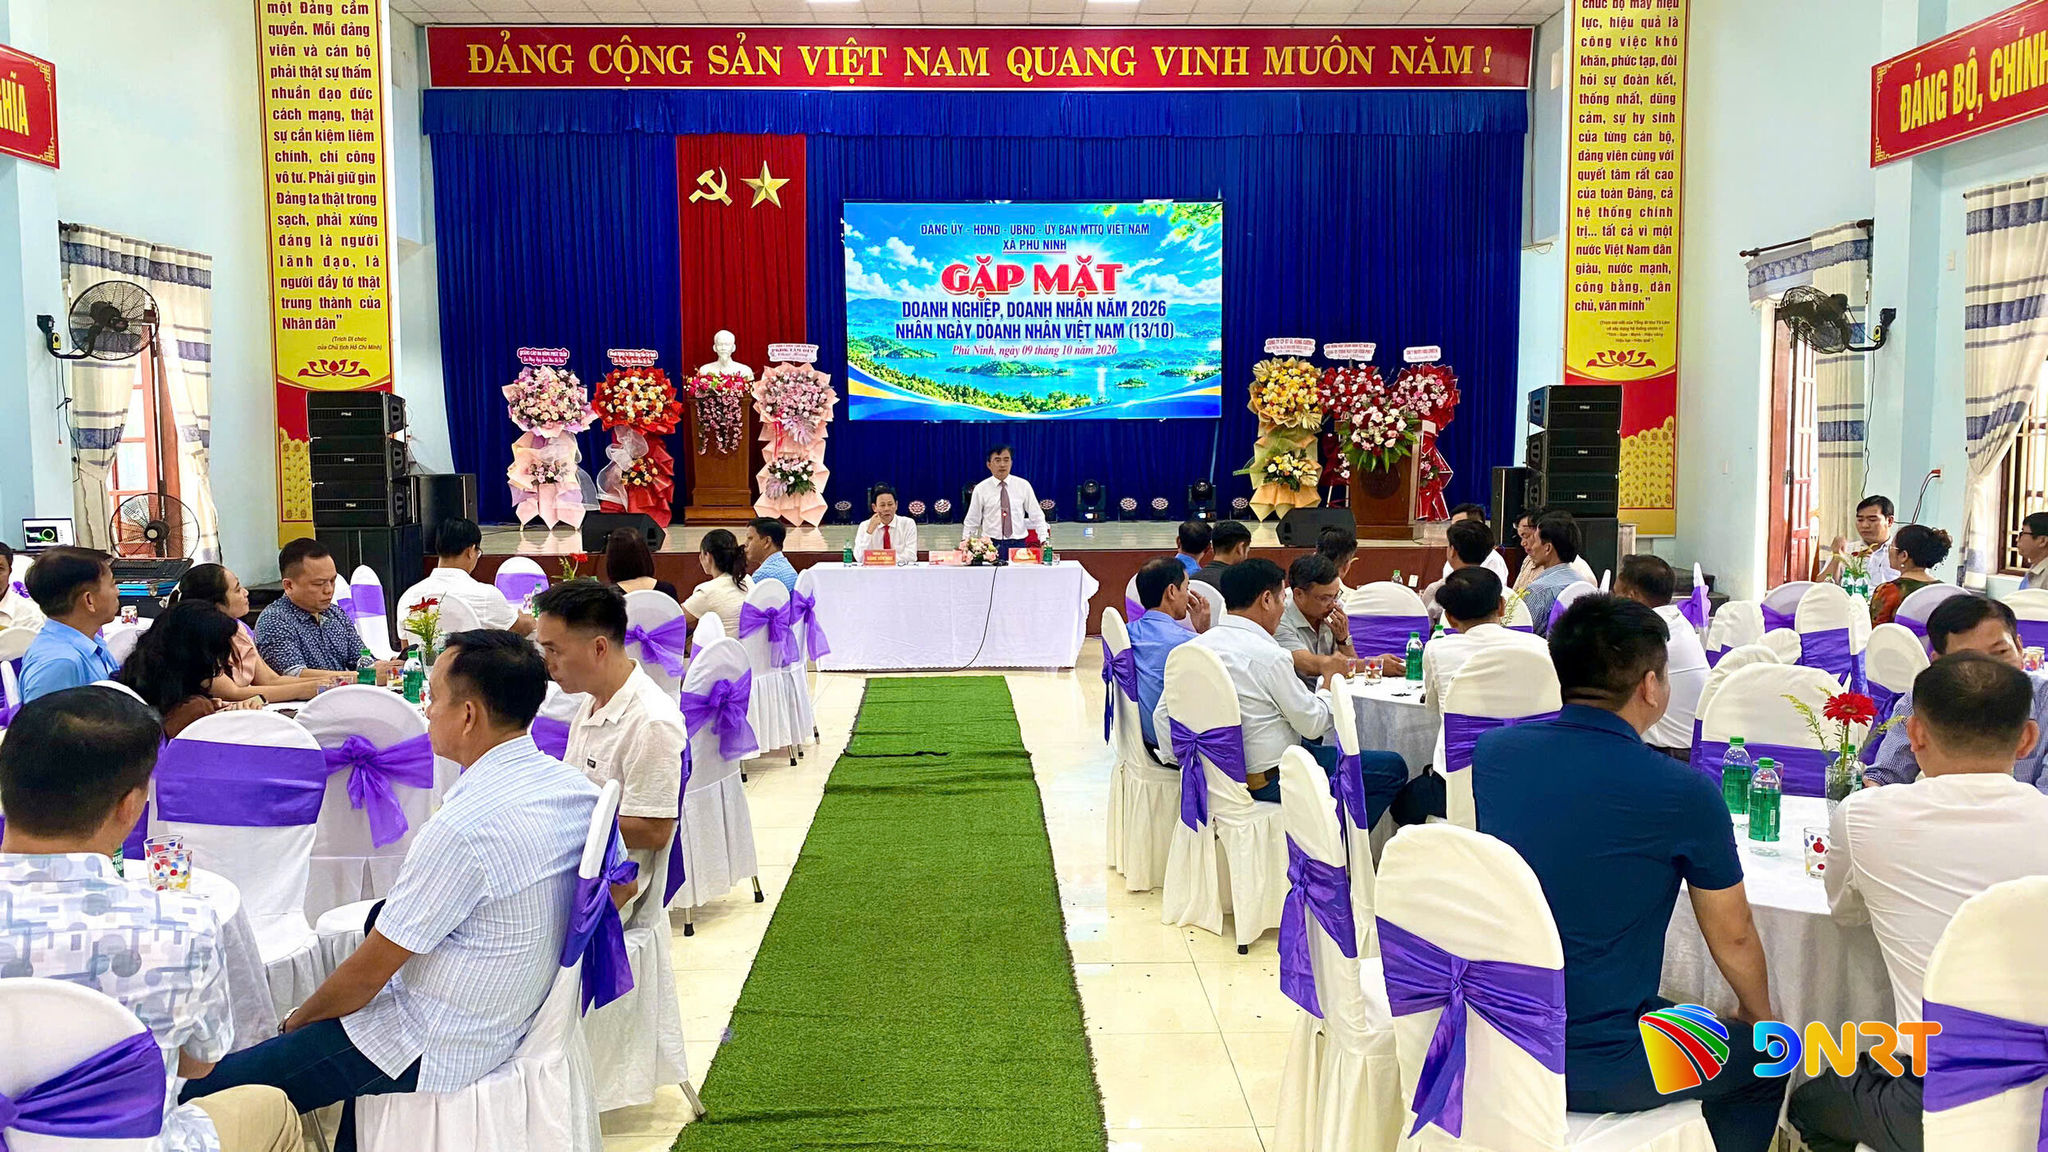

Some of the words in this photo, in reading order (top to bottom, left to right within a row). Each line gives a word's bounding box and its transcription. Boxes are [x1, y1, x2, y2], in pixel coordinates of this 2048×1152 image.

[268, 1, 291, 16] một
[300, 0, 332, 15] Đảng
[342, 0, 368, 14] cầm
[269, 21, 307, 36] quyền.
[313, 21, 335, 35] Mỗi
[341, 22, 369, 37] đảng
[1582, 17, 1602, 30] lực,
[1610, 17, 1633, 30] hiệu
[1641, 15, 1660, 29] quả
[1669, 16, 1678, 27] là
[1582, 36, 1611, 48] công
[1620, 36, 1646, 49] việc
[1656, 36, 1677, 46] khó
[269, 44, 295, 56] viên
[304, 44, 317, 56] và
[326, 45, 347, 57] cán
[356, 45, 370, 59] bộ
[467, 31, 574, 74] ĐẢNG
[588, 35, 693, 83] CỘNG
[708, 32, 783, 76] SẢN
[798, 37, 888, 85] VIỆT
[903, 46, 990, 77] NAM
[1006, 45, 1137, 83] QUANG
[1152, 45, 1249, 76] VINH
[1262, 35, 1375, 76] MUÔN
[1390, 37, 1474, 75] NĂM
[1581, 55, 1608, 67] khăn,
[1612, 55, 1636, 67] phức
[1640, 56, 1658, 68] tạp,
[1661, 55, 1677, 65] đòi
[271, 64, 296, 79] phải
[300, 66, 322, 80] thật
[326, 67, 339, 80] sự
[342, 64, 371, 78] thấm
[272, 85, 310, 99] nhuần
[319, 87, 341, 102] đạo
[350, 87, 372, 99] đức
[1900, 62, 1948, 133] ĐẢNG
[1953, 46, 1983, 122] BỘ,
[1580, 92, 1609, 105] thống
[1617, 91, 1642, 105] nhất,
[1650, 93, 1675, 105] dũng
[273, 108, 301, 120] cách
[308, 111, 344, 123] mạng,
[351, 108, 373, 123] thật
[1579, 111, 1605, 124] cảm,
[1613, 114, 1626, 125] sự
[1633, 112, 1645, 124] hy
[1653, 112, 1675, 123] sinh
[1579, 130, 1597, 142] của
[1604, 131, 1626, 143] từng
[1634, 131, 1652, 142] cán
[1659, 131, 1674, 144] bộ,
[275, 150, 311, 163] chính,
[320, 151, 338, 162] chí
[347, 151, 375, 164] công
[1579, 149, 1603, 162] đảng
[1607, 150, 1627, 161] viên
[1631, 150, 1656, 162] cùng
[1659, 150, 1673, 160] với
[1578, 167, 1605, 181] quyết
[1611, 169, 1630, 179] tâm
[1636, 167, 1649, 179] rất
[1655, 171, 1673, 179] cao
[1578, 187, 1596, 198] của
[1601, 188, 1622, 198] toàn
[1627, 187, 1656, 200] Đảng,
[1661, 187, 1673, 198] cả
[1577, 207, 1590, 220] hệ
[1599, 205, 1631, 218] thống
[1640, 206, 1672, 217] chính
[278, 214, 309, 228] sạch,
[317, 212, 341, 226] phải
[350, 214, 377, 227] xứng
[974, 224, 1000, 235] HĐND
[1010, 224, 1036, 235] UBND
[1058, 224, 1078, 235] BAN
[1081, 224, 1104, 236] MTTQ
[1106, 221, 1125, 235] VIỆT
[1128, 224, 1150, 235] NAM
[279, 234, 311, 247] đáng
[321, 234, 333, 246] là
[342, 235, 378, 247] người
[1043, 240, 1067, 250] NINH
[1576, 244, 1601, 255] nước
[1605, 244, 1623, 257] Việt
[1627, 244, 1649, 254] Nam
[1653, 244, 1671, 254] dân
[280, 255, 312, 267] lãnh
[324, 256, 355, 269] đạo,
[366, 255, 379, 267] là
[1576, 263, 1600, 275] giàu,
[1608, 263, 1632, 273] nước
[1640, 263, 1671, 275] mạnh,
[281, 276, 312, 289] người
[318, 274, 338, 289] đầy
[342, 276, 354, 287] tớ
[358, 276, 380, 290] thật
[941, 255, 1025, 299] GẶP
[1033, 255, 1124, 299] MẶT
[1576, 282, 1603, 293] công
[1651, 281, 1670, 292] dân
[281, 297, 311, 310] trung
[320, 297, 351, 308] thành
[360, 296, 380, 308] của
[903, 302, 948, 318] DOANH
[953, 298, 1003, 321] NGHIỆP,
[1008, 302, 1052, 318] DOANH
[1057, 298, 1093, 318] NHÂN
[1097, 298, 1128, 317] NĂM
[1132, 301, 1167, 317] 2026
[1575, 299, 1596, 312] chủ,
[1599, 300, 1616, 310] văn
[283, 318, 312, 329] Nhân
[896, 320, 933, 339] NHÂN
[937, 320, 972, 339] NGÀY
[977, 323, 1021, 339] DOANH
[1025, 320, 1061, 339] NHÂN
[1065, 320, 1091, 341] VIỆT
[1095, 323, 1125, 339] NAM
[1129, 322, 1174, 340] (13/10)
[952, 344, 970, 355] Phú
[999, 347, 1019, 358] ngày
[1022, 345, 1033, 355] 09
[1035, 345, 1060, 357] tháng
[1062, 345, 1073, 355] 10
[1075, 347, 1094, 355] năm
[1097, 345, 1117, 355] 2026
